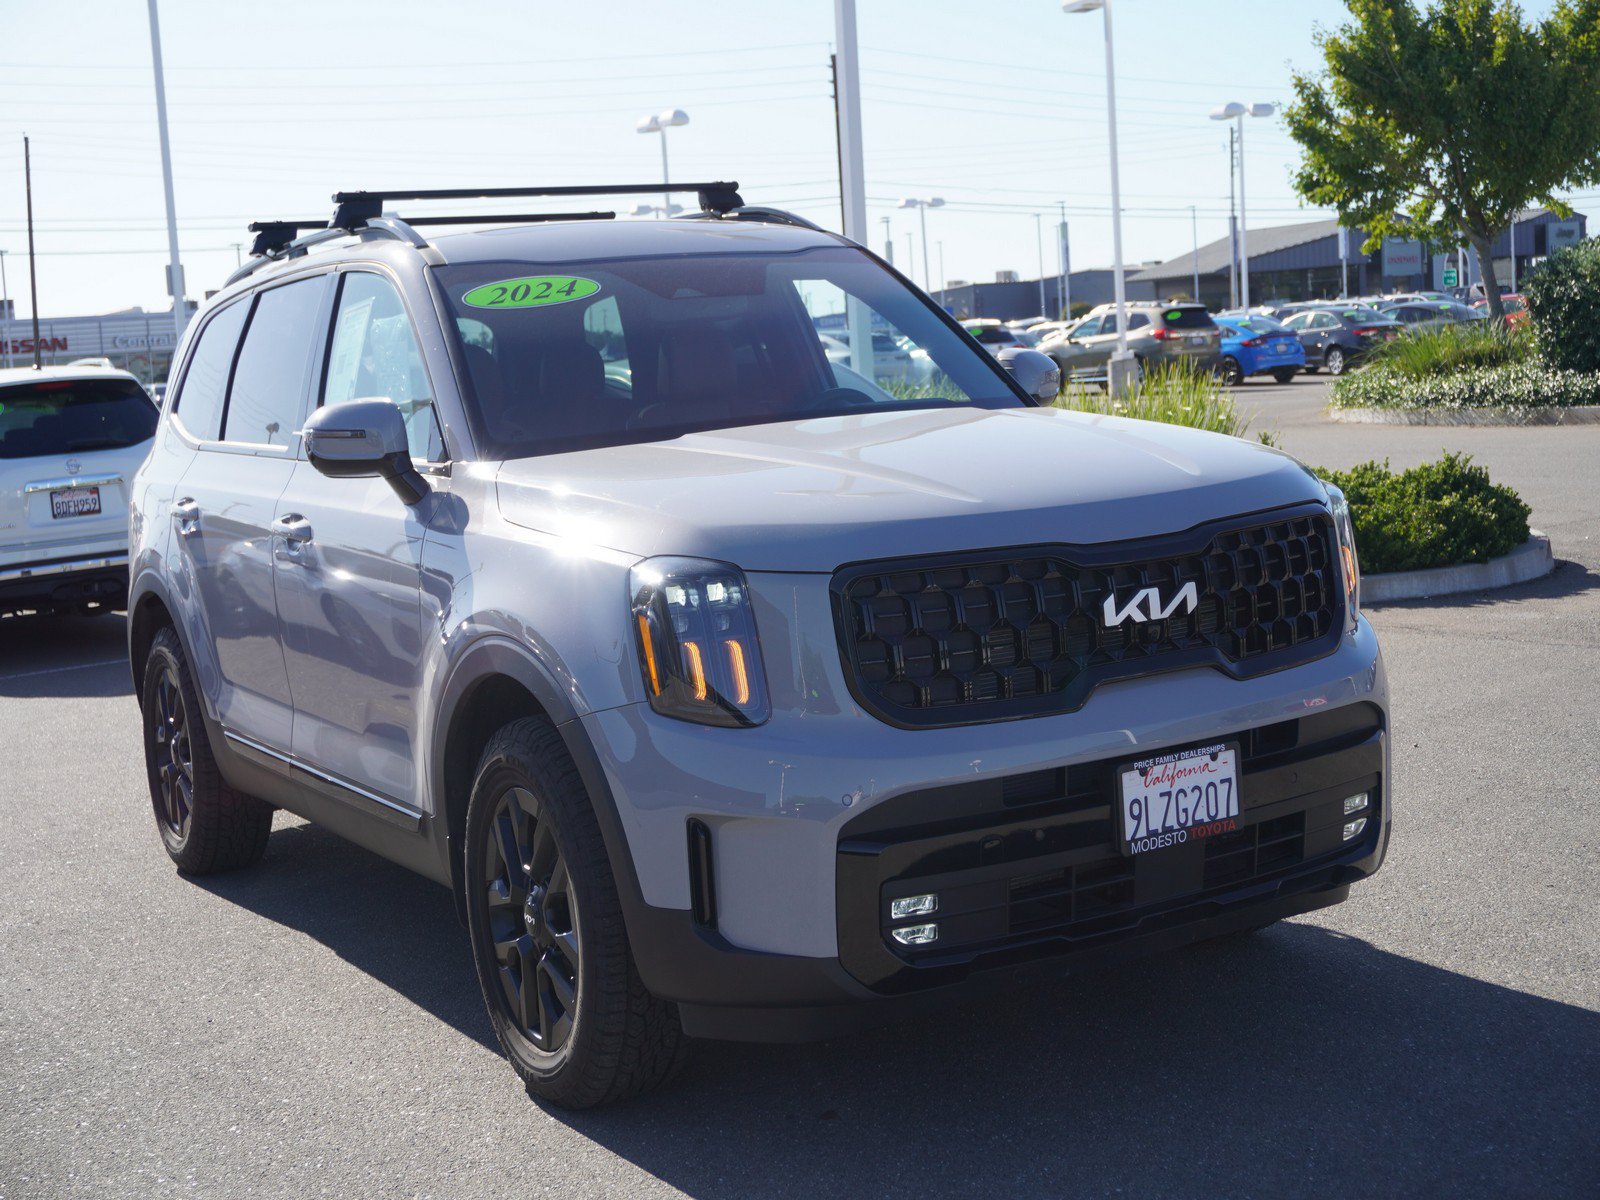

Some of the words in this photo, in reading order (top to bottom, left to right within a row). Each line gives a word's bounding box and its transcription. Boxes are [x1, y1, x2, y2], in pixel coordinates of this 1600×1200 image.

[487, 279, 578, 306] 2024
[56, 499, 97, 514] 8DFH959
[1103, 581, 1198, 627] KIA
[1133, 759, 1154, 770] PRICE
[1155, 753, 1179, 766] FAMILY
[1180, 743, 1226, 760] DEALERSHIPS
[1144, 758, 1217, 788] California
[1129, 777, 1233, 840] 9LZG207
[1131, 830, 1187, 855] MODESTO
[1190, 819, 1237, 840] TOYOTA
